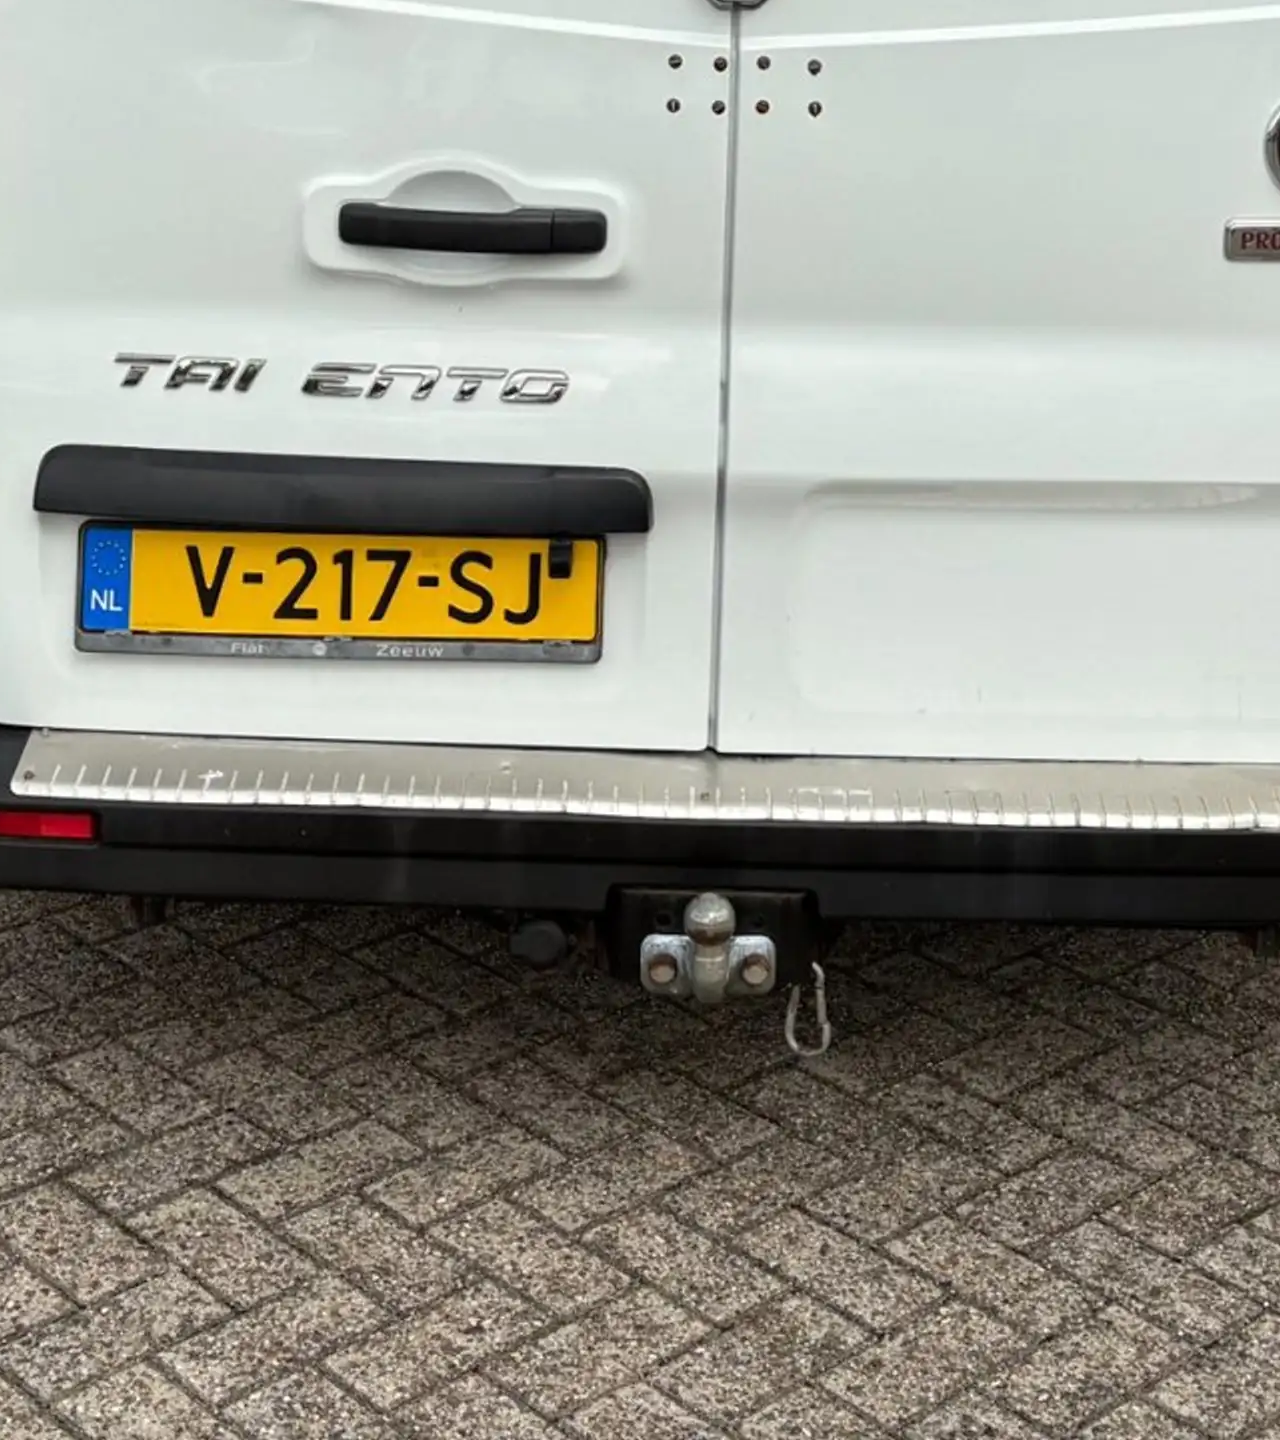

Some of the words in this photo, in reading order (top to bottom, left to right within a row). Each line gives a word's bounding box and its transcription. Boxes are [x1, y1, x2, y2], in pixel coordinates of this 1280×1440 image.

[184, 543, 542, 625] V-217-SJ
[90, 588, 122, 613] NL
[230, 641, 265, 655] Fiat
[375, 643, 445, 658] Zeeuw
